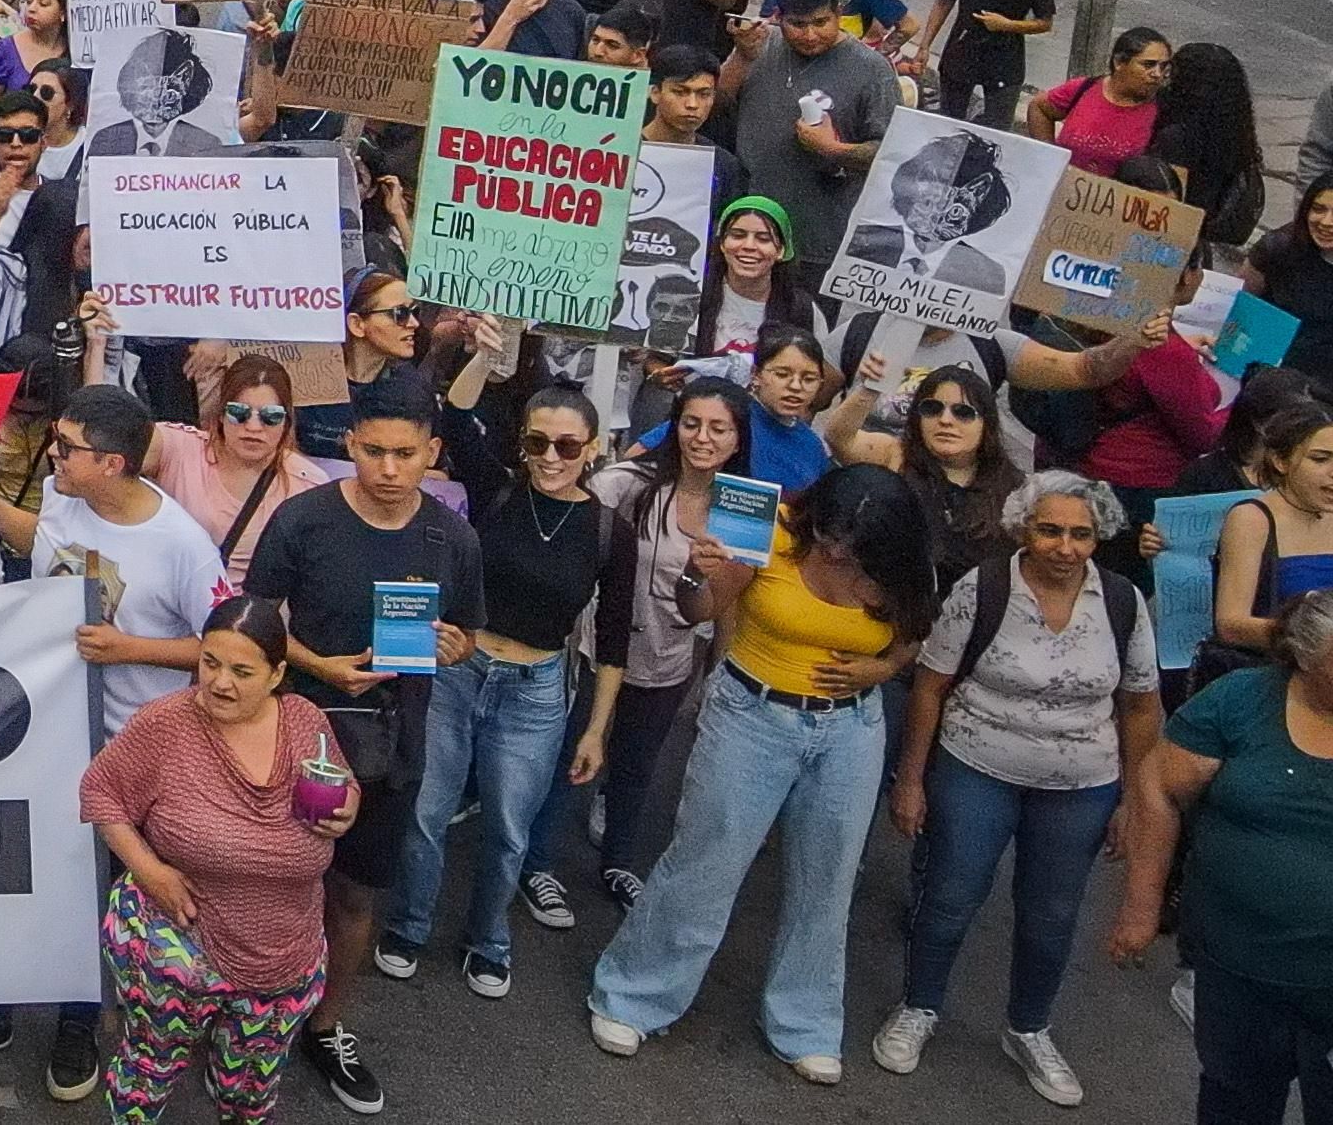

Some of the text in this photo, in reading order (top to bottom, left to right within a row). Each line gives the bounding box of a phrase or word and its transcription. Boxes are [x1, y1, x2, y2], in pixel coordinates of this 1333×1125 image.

[452, 55, 638, 120] YO NO CAÍ
[498, 111, 568, 143] en la
[437, 125, 631, 191] EDUCACIÓN
[115, 173, 287, 192] DESFINANCIAR LA
[451, 164, 603, 228] PÚBLICA
[1064, 177, 1086, 213] SI
[1089, 180, 1116, 217] LA
[120, 208, 310, 231] EDUCACIÓN PÚBLICA
[624, 241, 677, 258] VENDO
[631, 230, 671, 245] TE LA
[204, 246, 229, 263] ES
[445, 246, 479, 274] me
[848, 264, 888, 287] OJO
[96, 283, 343, 311] DESTRUIR FUTUROS
[492, 280, 611, 327] COLECTIVOS
[830, 277, 998, 335] ESTAMOS VIGILANDO
